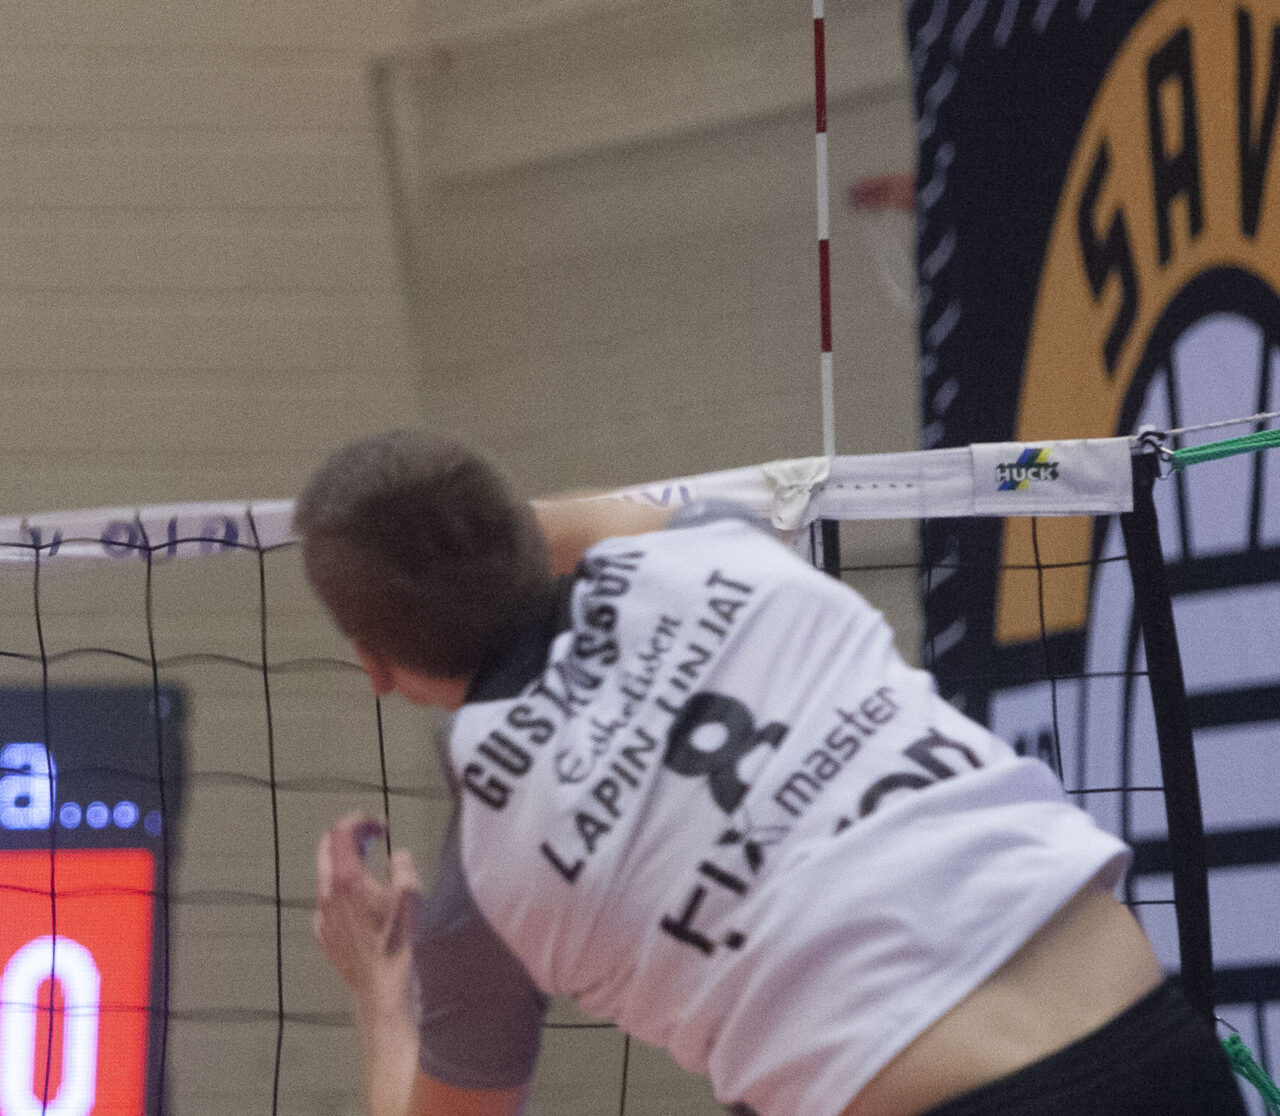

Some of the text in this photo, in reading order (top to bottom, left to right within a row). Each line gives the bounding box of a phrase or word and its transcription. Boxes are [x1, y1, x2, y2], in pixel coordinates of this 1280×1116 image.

[997, 462, 1059, 483] HUCK
[540, 724, 658, 886] LAPIN
[663, 690, 789, 816] 8
